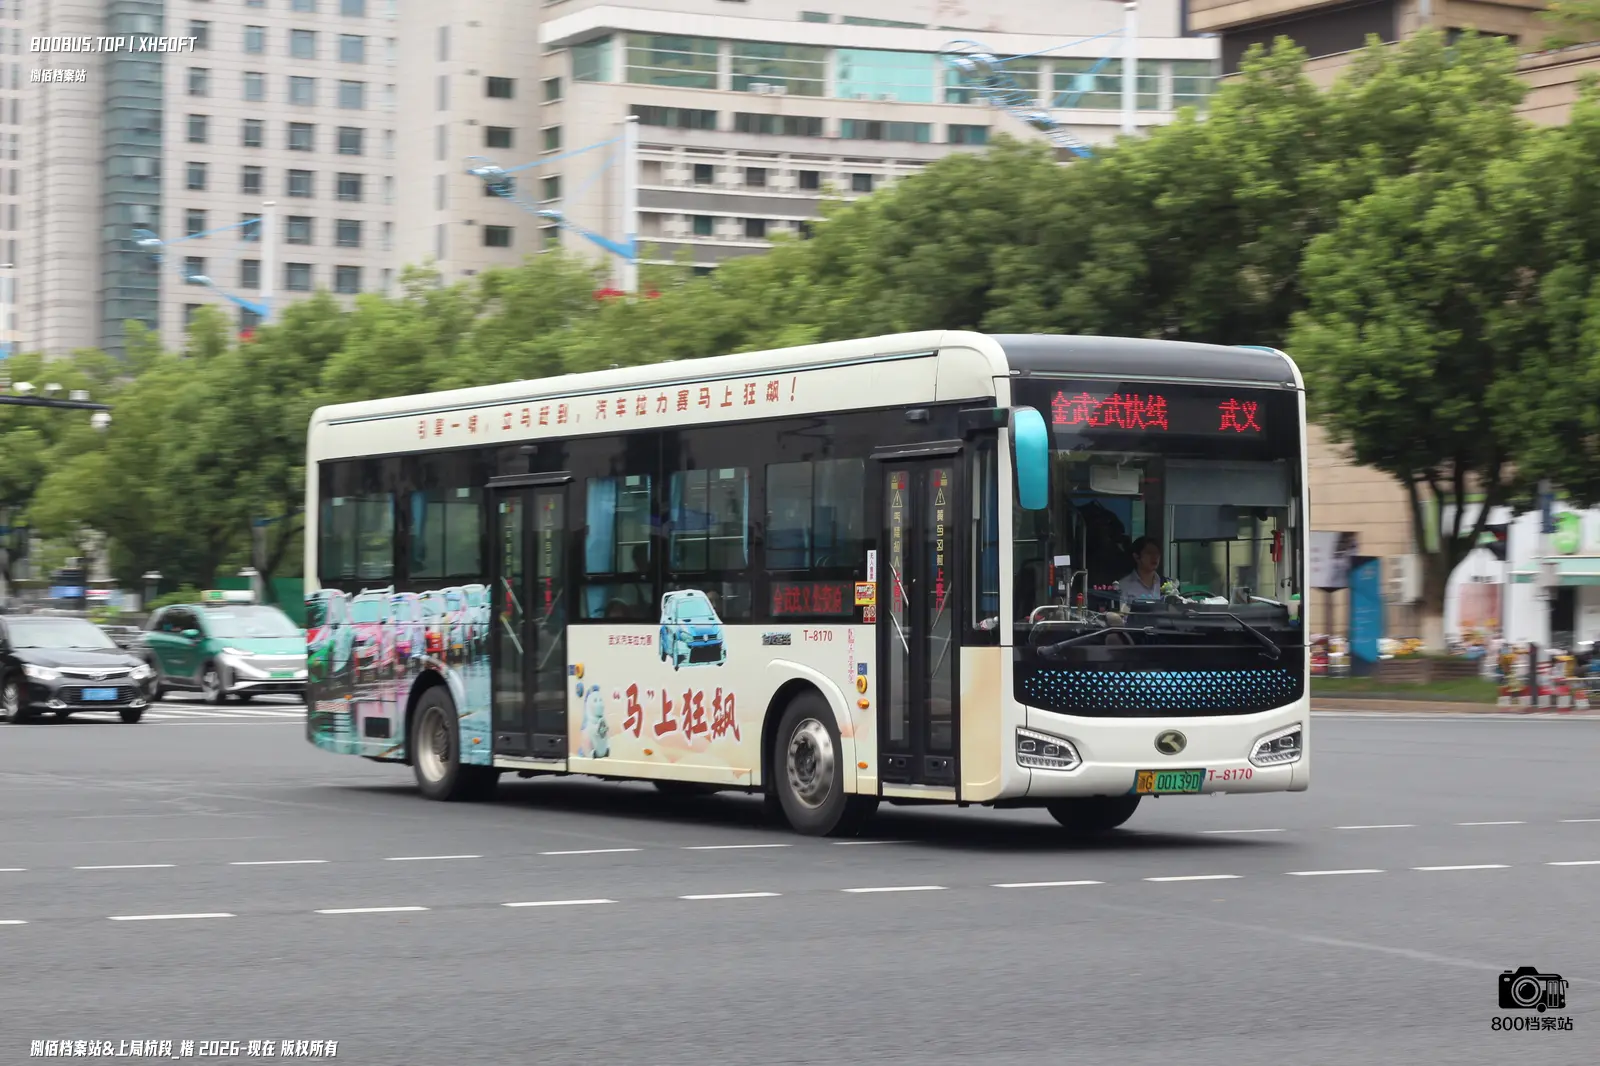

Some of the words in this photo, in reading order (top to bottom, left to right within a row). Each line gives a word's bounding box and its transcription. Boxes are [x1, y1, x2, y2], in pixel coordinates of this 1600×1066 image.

[1218, 398, 1261, 432] 武义
[803, 629, 834, 642] T-8170
[1207, 768, 1253, 782] T-8170
